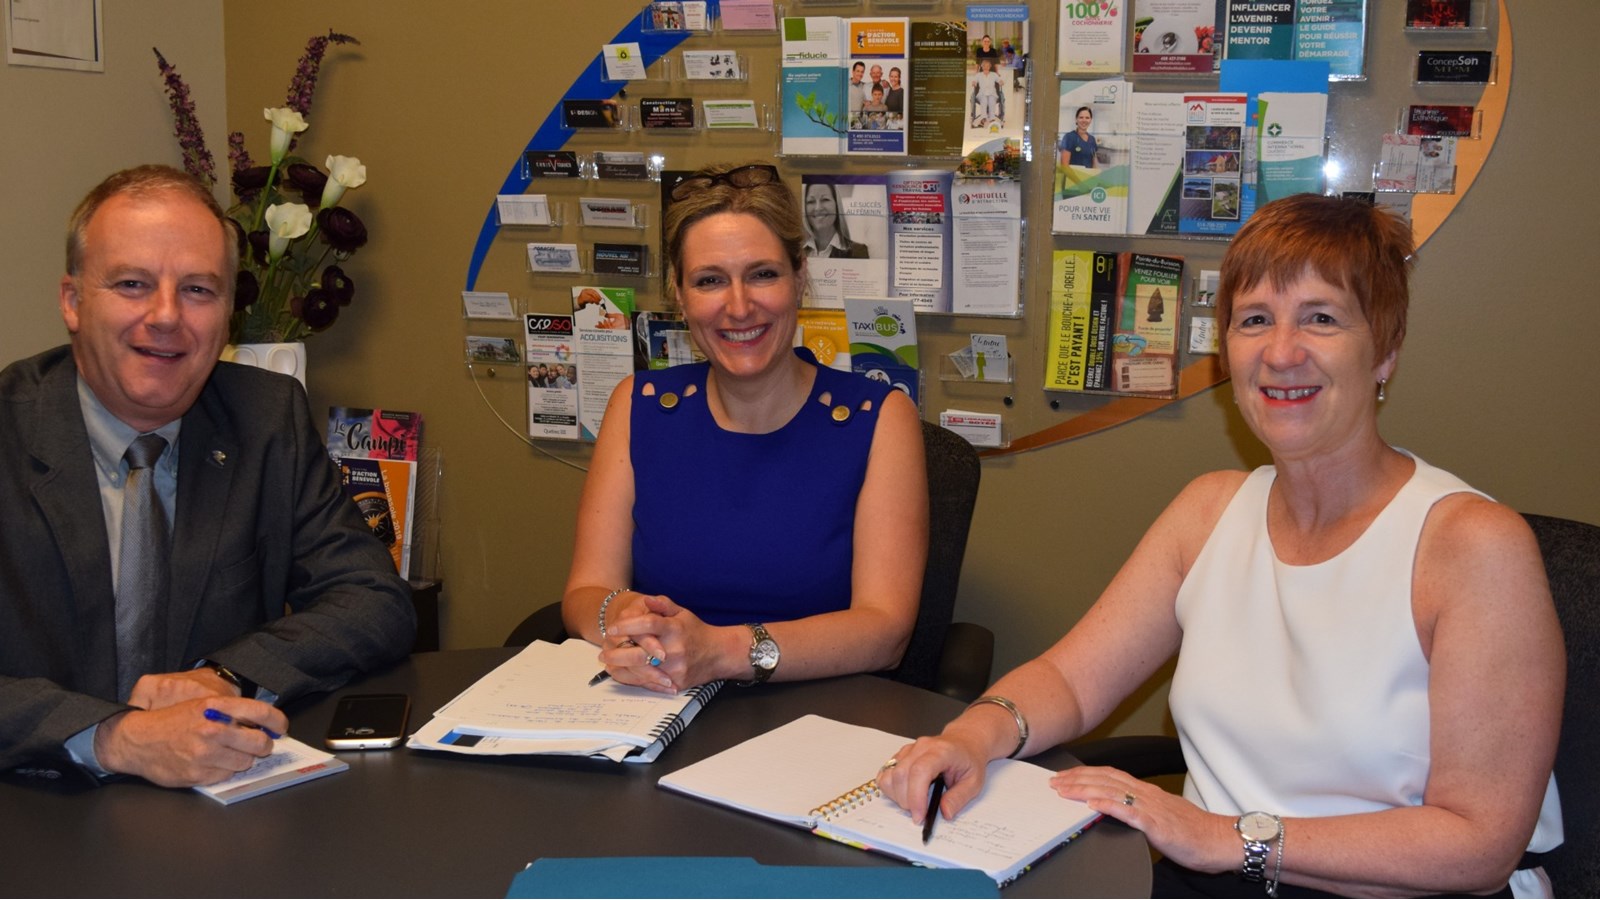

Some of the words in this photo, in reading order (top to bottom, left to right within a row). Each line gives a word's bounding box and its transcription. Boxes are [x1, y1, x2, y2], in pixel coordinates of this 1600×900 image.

[1231, 4, 1291, 12] INFLUENCER
[1231, 15, 1273, 23] L'AVENIR
[1230, 37, 1270, 45] MENTOR
[1426, 56, 1479, 67] ConcepSon
[1058, 206, 1080, 214] POUR
[1083, 212, 1111, 222] SANTÉ!
[1134, 268, 1152, 276] VENEZ
[1153, 271, 1178, 280] FOUILLER
[580, 334, 628, 343] ACQUISITIONS
[1062, 334, 1071, 342] LE
[1072, 322, 1084, 357] PAYANT
[1060, 344, 1070, 359] QUE
[1056, 361, 1068, 384] PARCE
[1068, 360, 1081, 385] C'EST
[334, 418, 346, 437] Le
[347, 422, 406, 459] Campi
[382, 470, 388, 480] La
[384, 482, 397, 519] boussole
